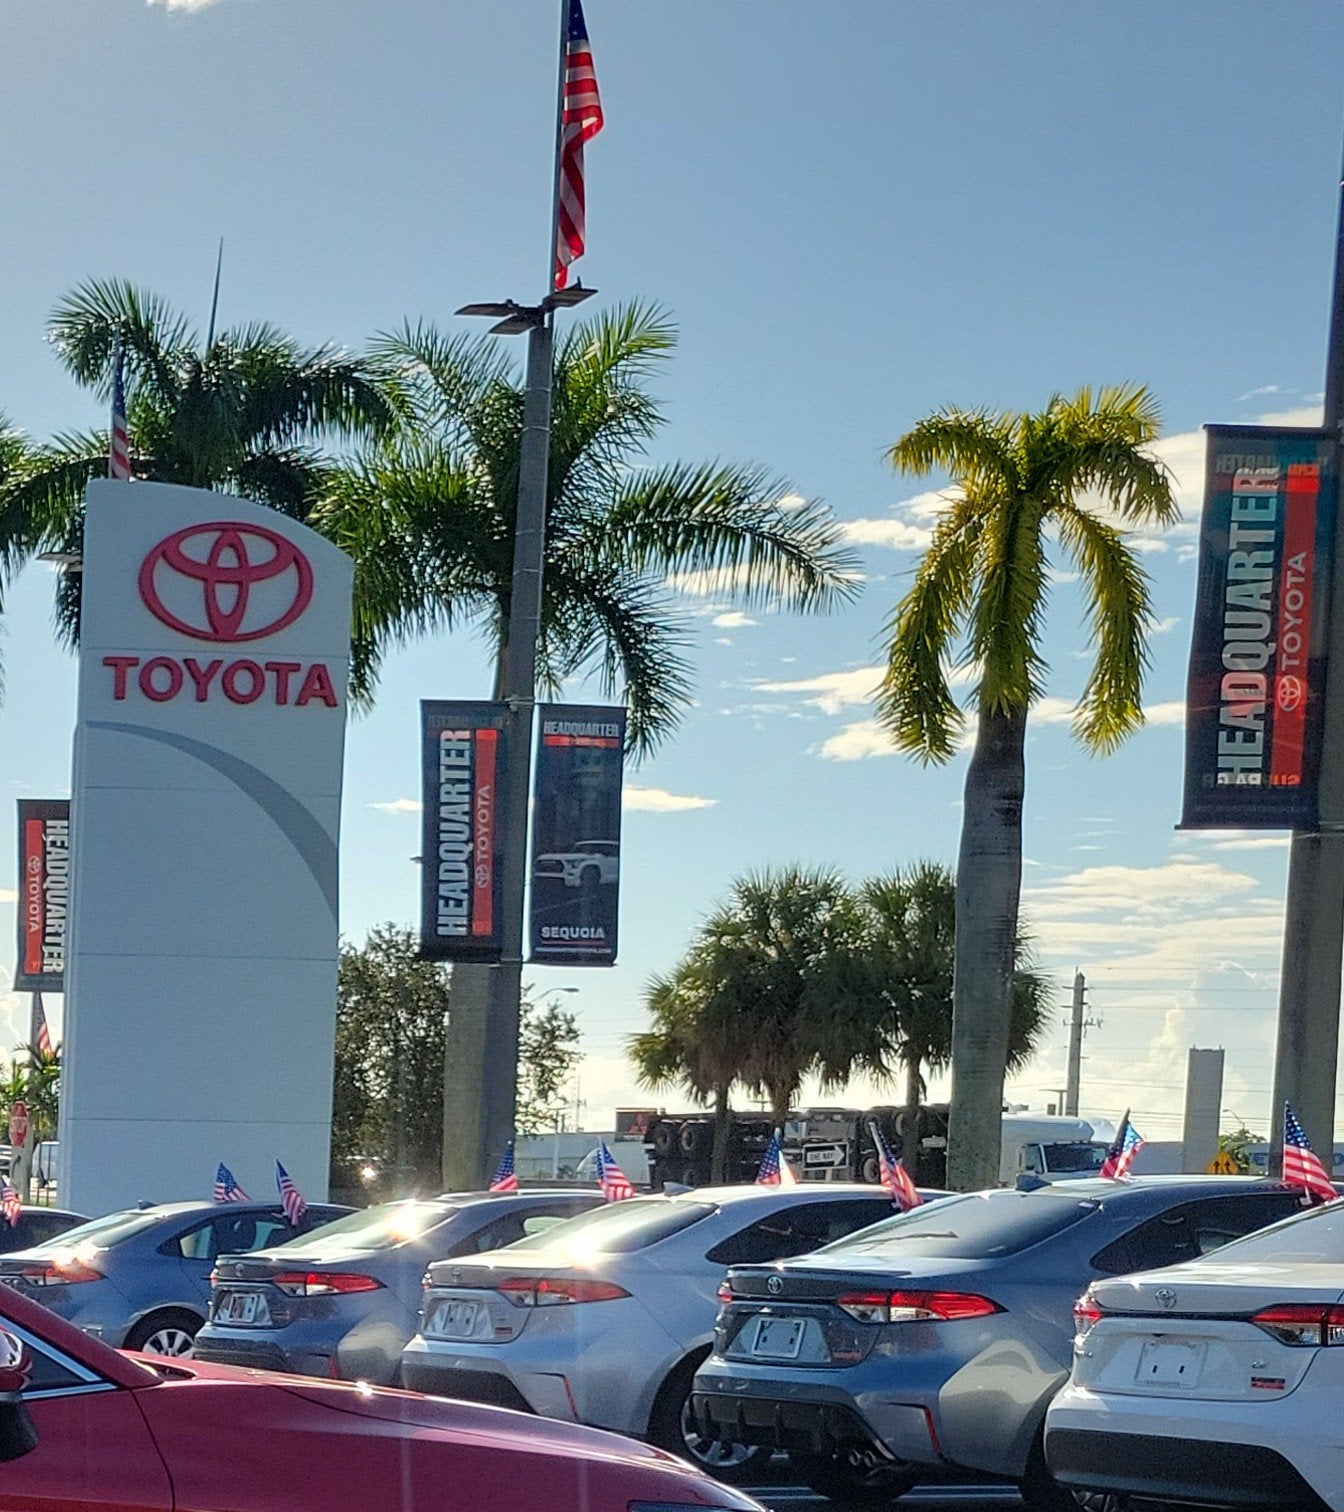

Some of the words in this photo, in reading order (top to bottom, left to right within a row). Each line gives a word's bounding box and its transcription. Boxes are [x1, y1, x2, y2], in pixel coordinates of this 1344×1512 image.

[1216, 466, 1280, 785] HEADQUARTER
[1280, 551, 1308, 671] TOYOTA
[102, 656, 339, 708] TOYOTA
[543, 720, 619, 736] HEADQUARTER
[437, 729, 473, 936] HEADQUARTER
[477, 785, 491, 862] TOYOTA
[29, 879, 40, 933] TOYOTA
[41, 820, 69, 973] HEADQUARTER
[541, 927, 605, 939] SEQUOIA
